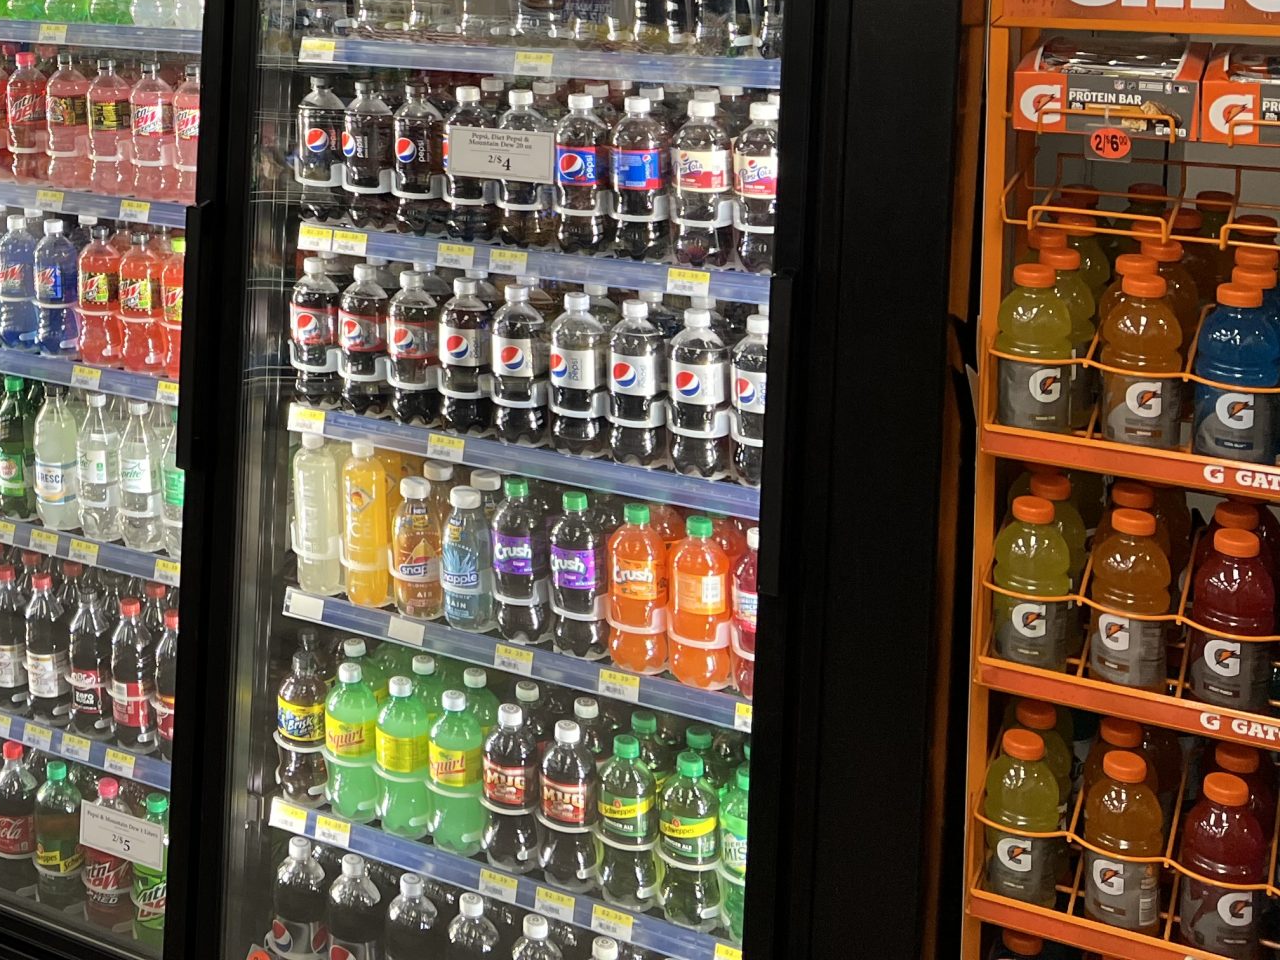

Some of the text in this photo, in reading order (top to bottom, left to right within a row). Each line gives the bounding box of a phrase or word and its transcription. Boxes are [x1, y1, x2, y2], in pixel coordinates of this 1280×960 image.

[1020, 83, 1063, 124] G
[1068, 90, 1142, 105] PROTEIN BAR
[1208, 94, 1256, 136] G
[418, 139, 426, 164] pepsi
[487, 154, 512, 171] 2/$4
[585, 154, 595, 180] pepsi
[1028, 367, 1062, 404] G
[1125, 381, 1163, 418] G
[1215, 391, 1256, 430] G
[1203, 464, 1225, 484] G
[494, 543, 532, 561] Crush
[550, 554, 587, 575] Crush
[613, 567, 654, 585] Crush
[1011, 602, 1047, 639] G
[1098, 612, 1131, 651] G
[1203, 638, 1242, 677] G
[327, 725, 365, 749] Squirt
[1199, 711, 1280, 741] G GAT
[486, 769, 526, 790] MUG
[543, 786, 585, 809] MUG
[603, 804, 637, 817] Schweppes
[663, 823, 695, 835] Schweppes
[996, 837, 1033, 873] G
[1092, 858, 1125, 896] G
[1216, 891, 1254, 927] G
